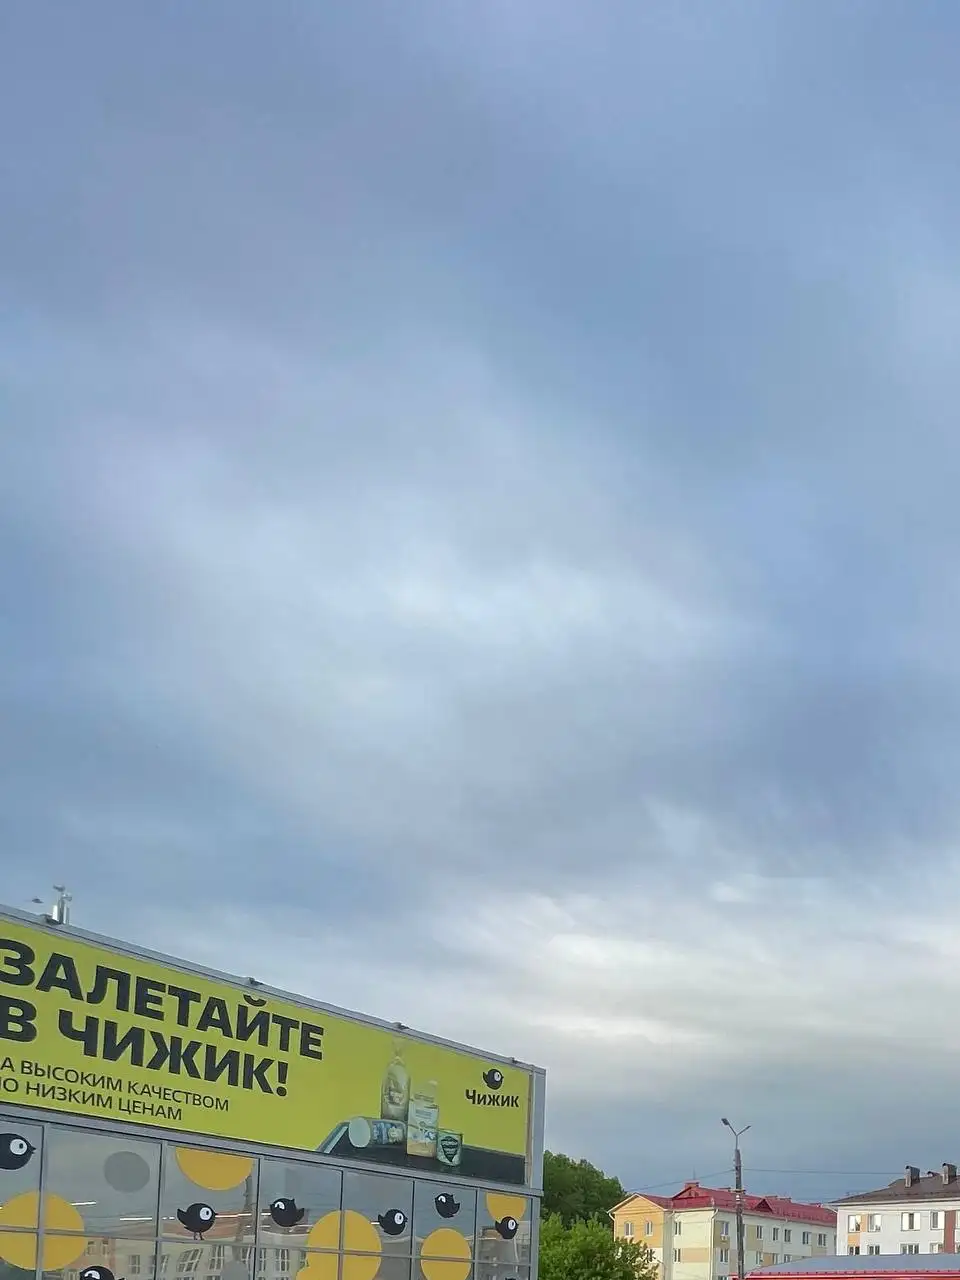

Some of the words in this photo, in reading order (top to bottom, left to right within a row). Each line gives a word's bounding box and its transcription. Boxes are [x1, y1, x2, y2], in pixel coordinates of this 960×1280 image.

[0, 938, 324, 1060] ЗАЛЕТАЙТЕ
[0, 995, 37, 1042] В
[58, 1009, 288, 1097] ЧИЖИК!
[0, 1056, 15, 1073] А
[21, 1060, 122, 1092] ВЫСОКИМ
[127, 1081, 229, 1112] КАЧЕСТВОМ
[0, 1077, 19, 1093] О
[26, 1081, 113, 1109] НИЗКИМ
[118, 1097, 182, 1121] ЦЕНАМ
[465, 1089, 520, 1108] Чижик
